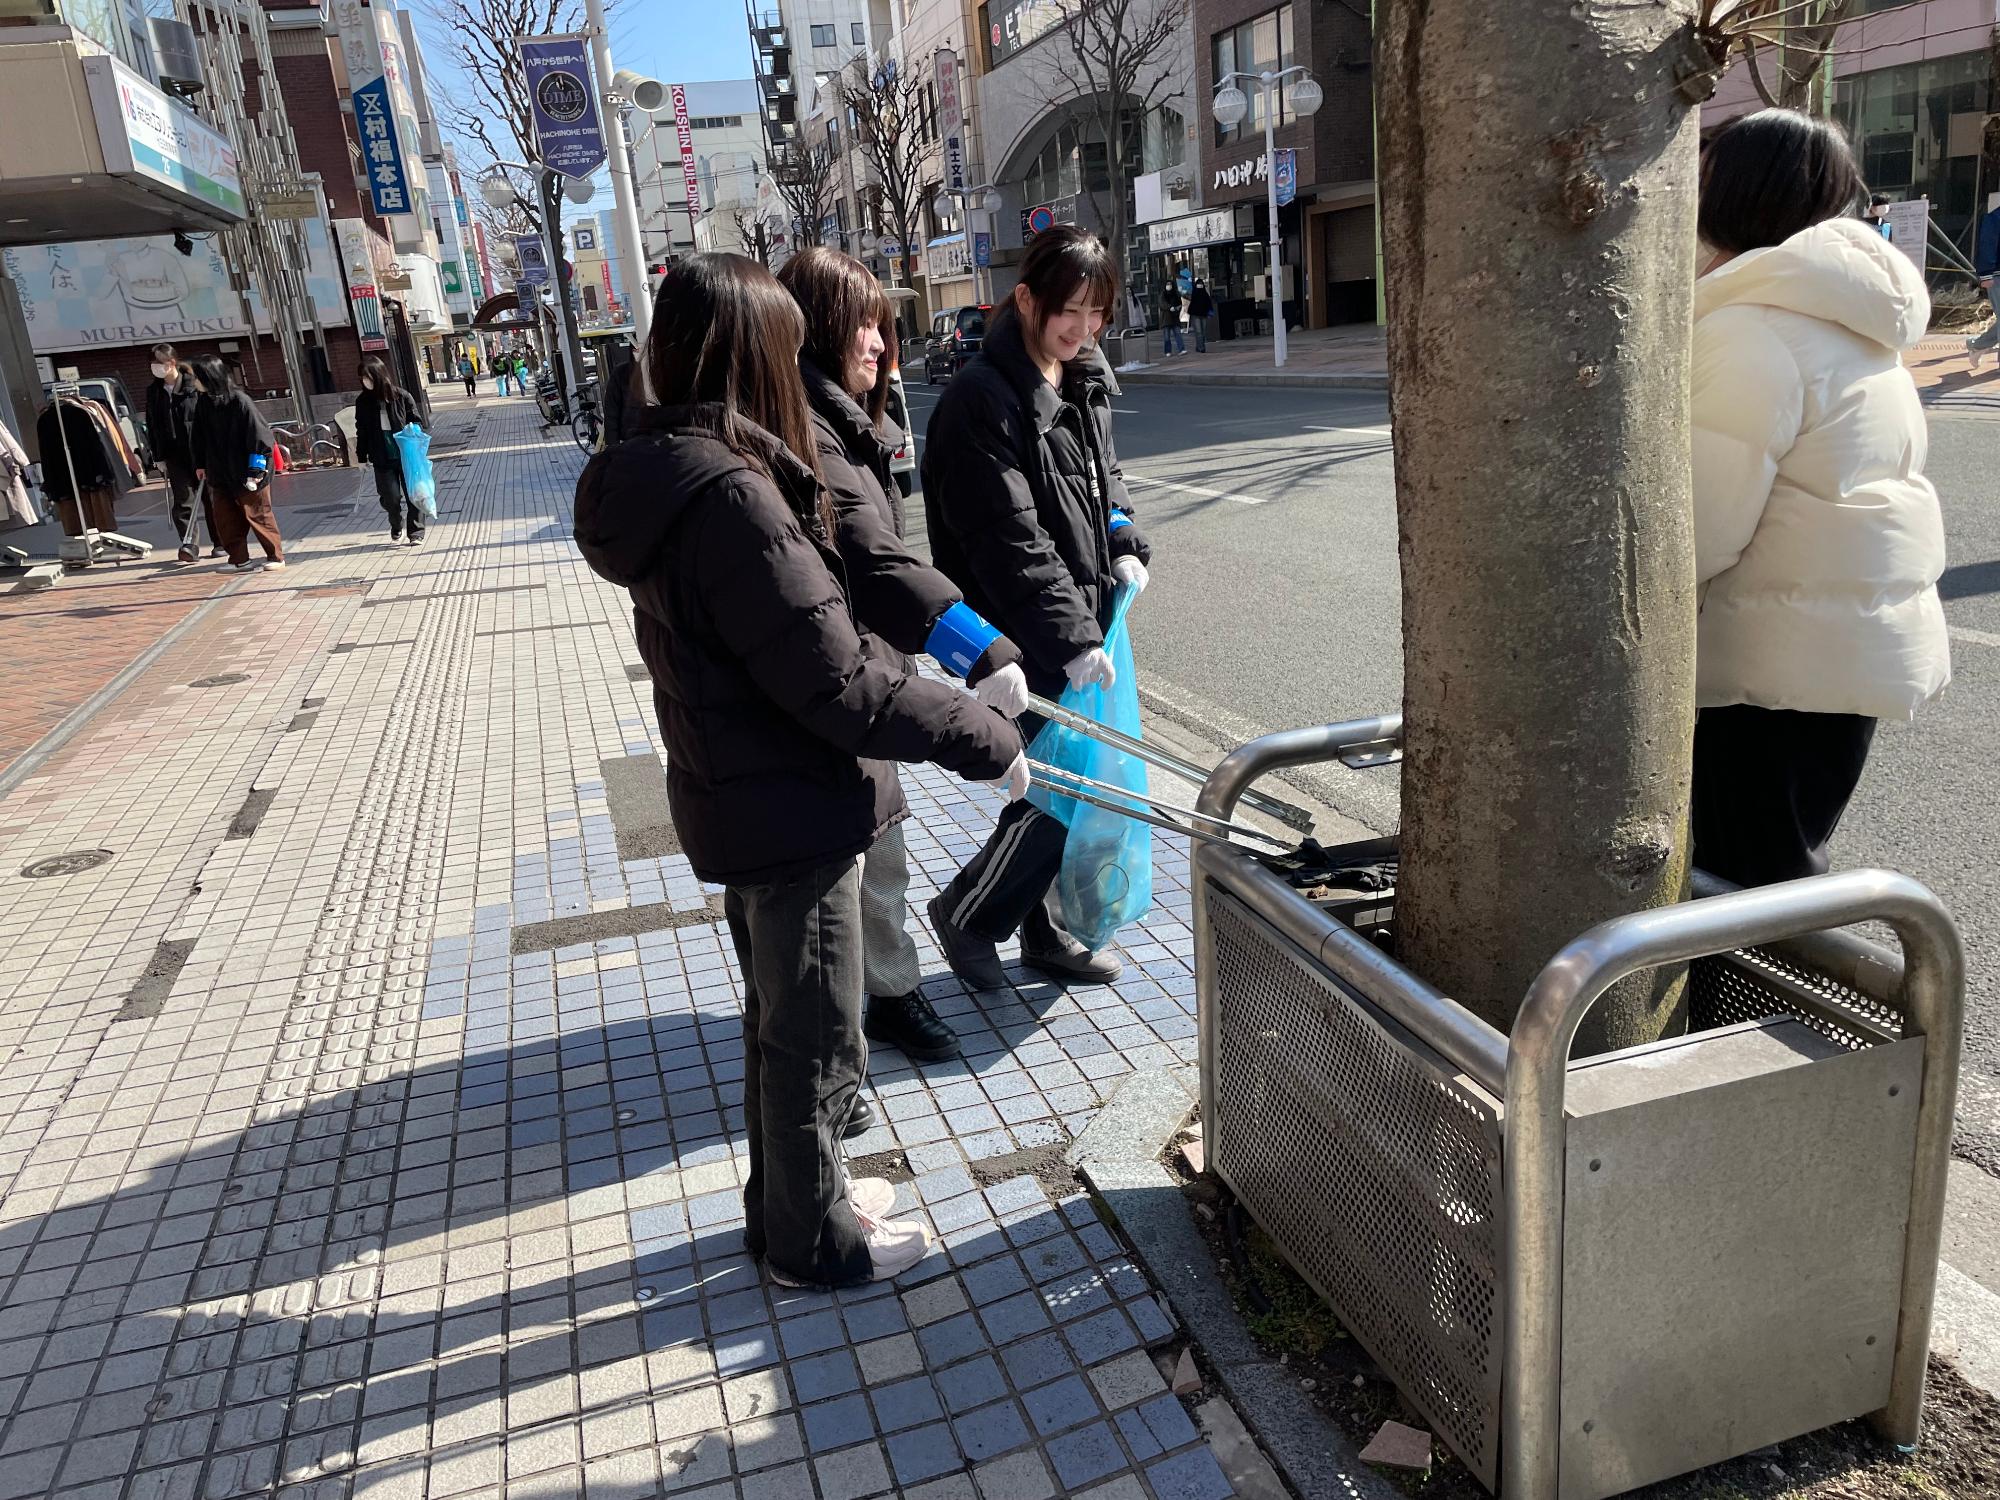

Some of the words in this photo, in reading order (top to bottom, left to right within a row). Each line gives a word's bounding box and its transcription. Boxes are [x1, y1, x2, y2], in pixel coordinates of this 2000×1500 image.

[541, 89, 584, 105] DIME
[540, 130, 581, 140] HACHINOHE
[582, 127, 599, 136] DIME
[364, 115, 404, 209] 村福本店
[671, 85, 692, 149] KOUSHIN
[682, 153, 700, 217] BUILDING
[577, 231, 592, 248] P
[80, 316, 236, 344] MURAFUKU
